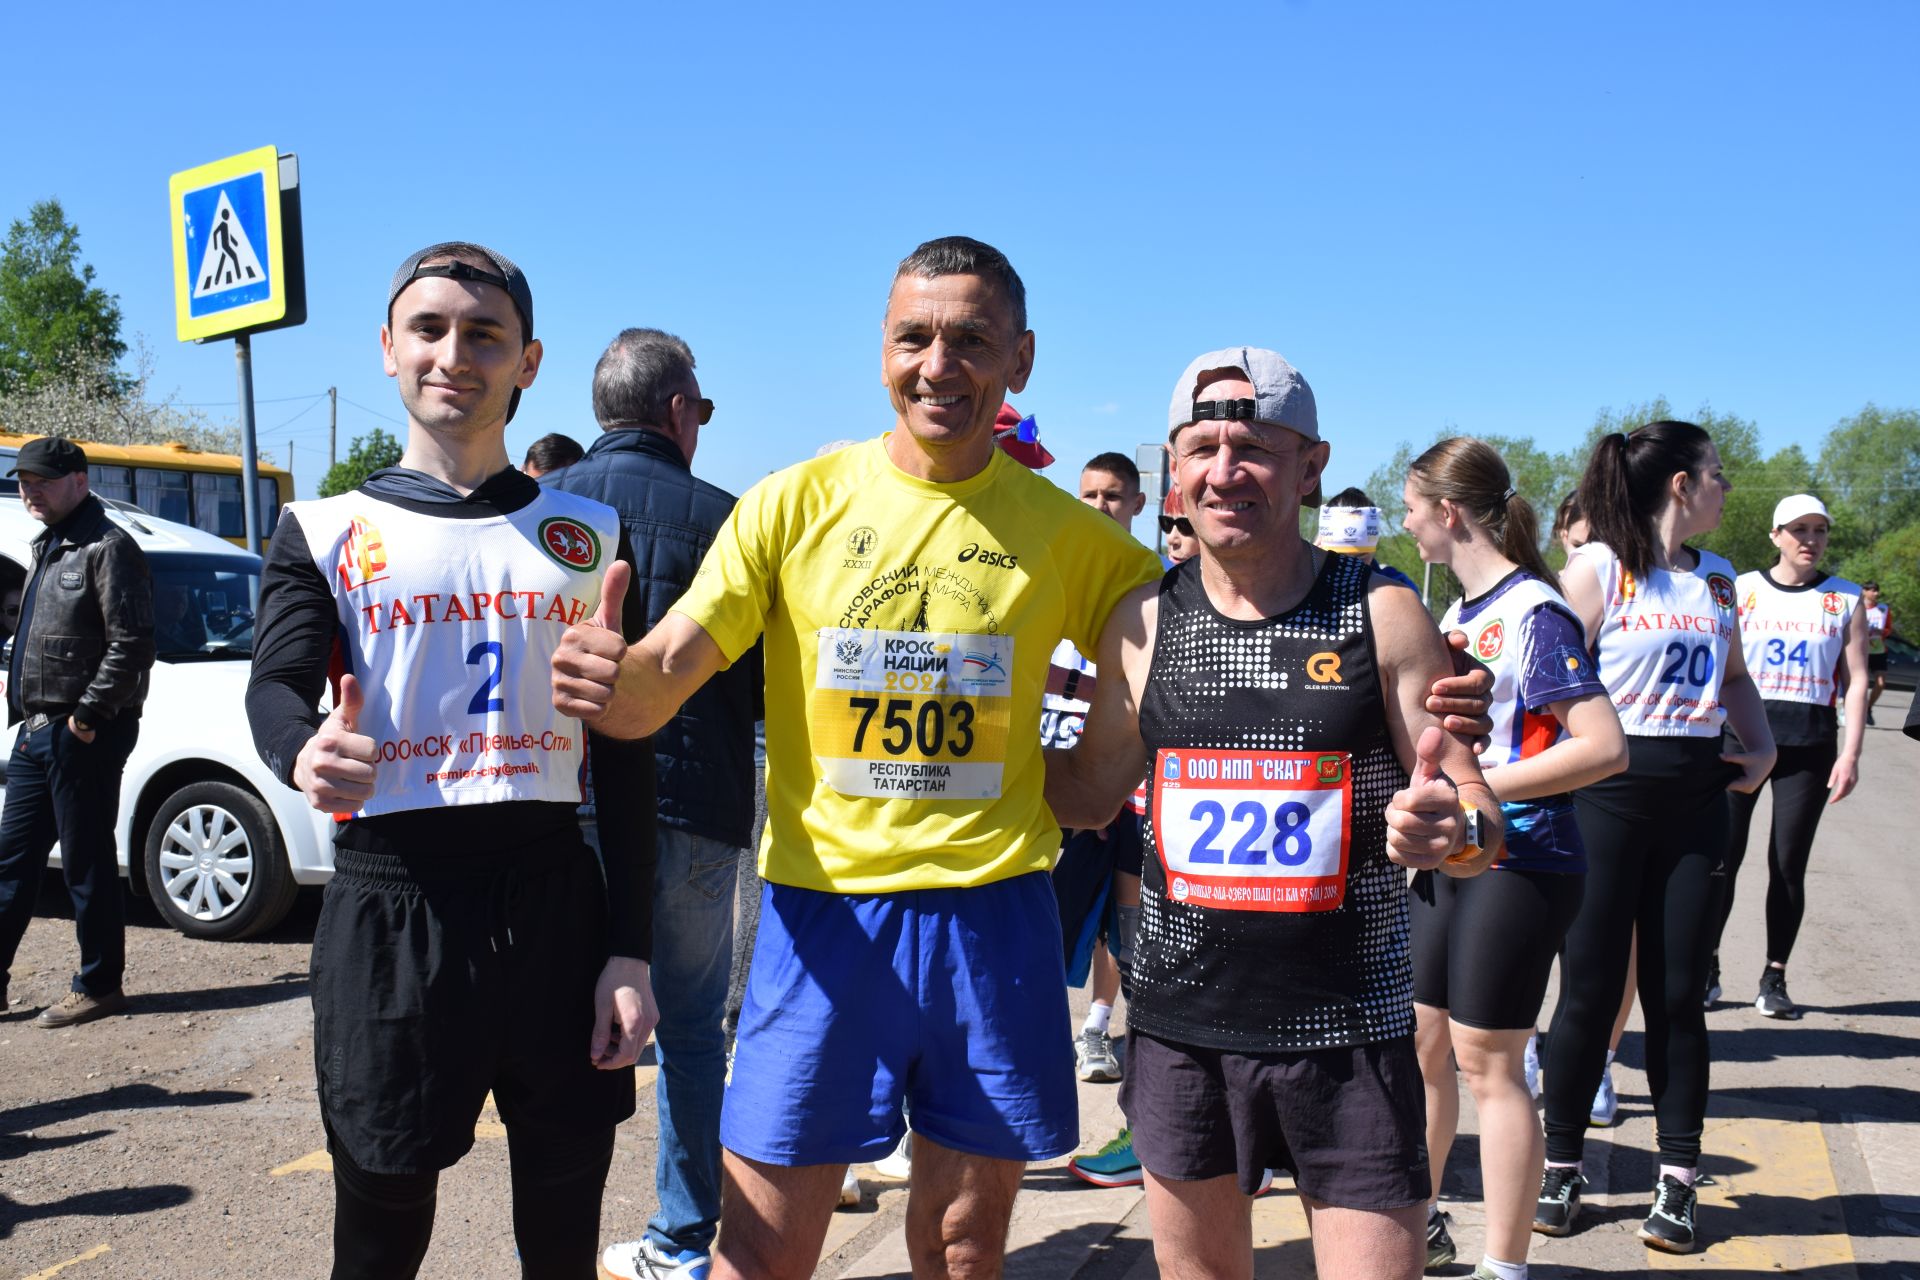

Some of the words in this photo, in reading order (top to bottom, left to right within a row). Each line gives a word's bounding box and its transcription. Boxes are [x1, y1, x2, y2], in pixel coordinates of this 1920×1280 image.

[932, 582, 971, 612] МИРА
[362, 590, 588, 635] ТАТАРСТАН
[1616, 613, 1732, 643] ТАТАРСТАН
[1743, 619, 1838, 638] ТАТАРСТАН
[885, 639, 935, 655] КРОСС
[1767, 638, 1809, 667] 34
[466, 641, 505, 715] 2
[884, 655, 948, 673] НАЦИИ
[1659, 641, 1714, 687] 20
[884, 672, 949, 692] 2024
[849, 697, 975, 757] 7503
[869, 762, 951, 778] РЕСПУБЛИКА
[1187, 758, 1218, 780] ООО
[1222, 758, 1253, 780] НПП
[873, 777, 946, 792] ТАТАРСТАН
[1188, 800, 1313, 866] 228
